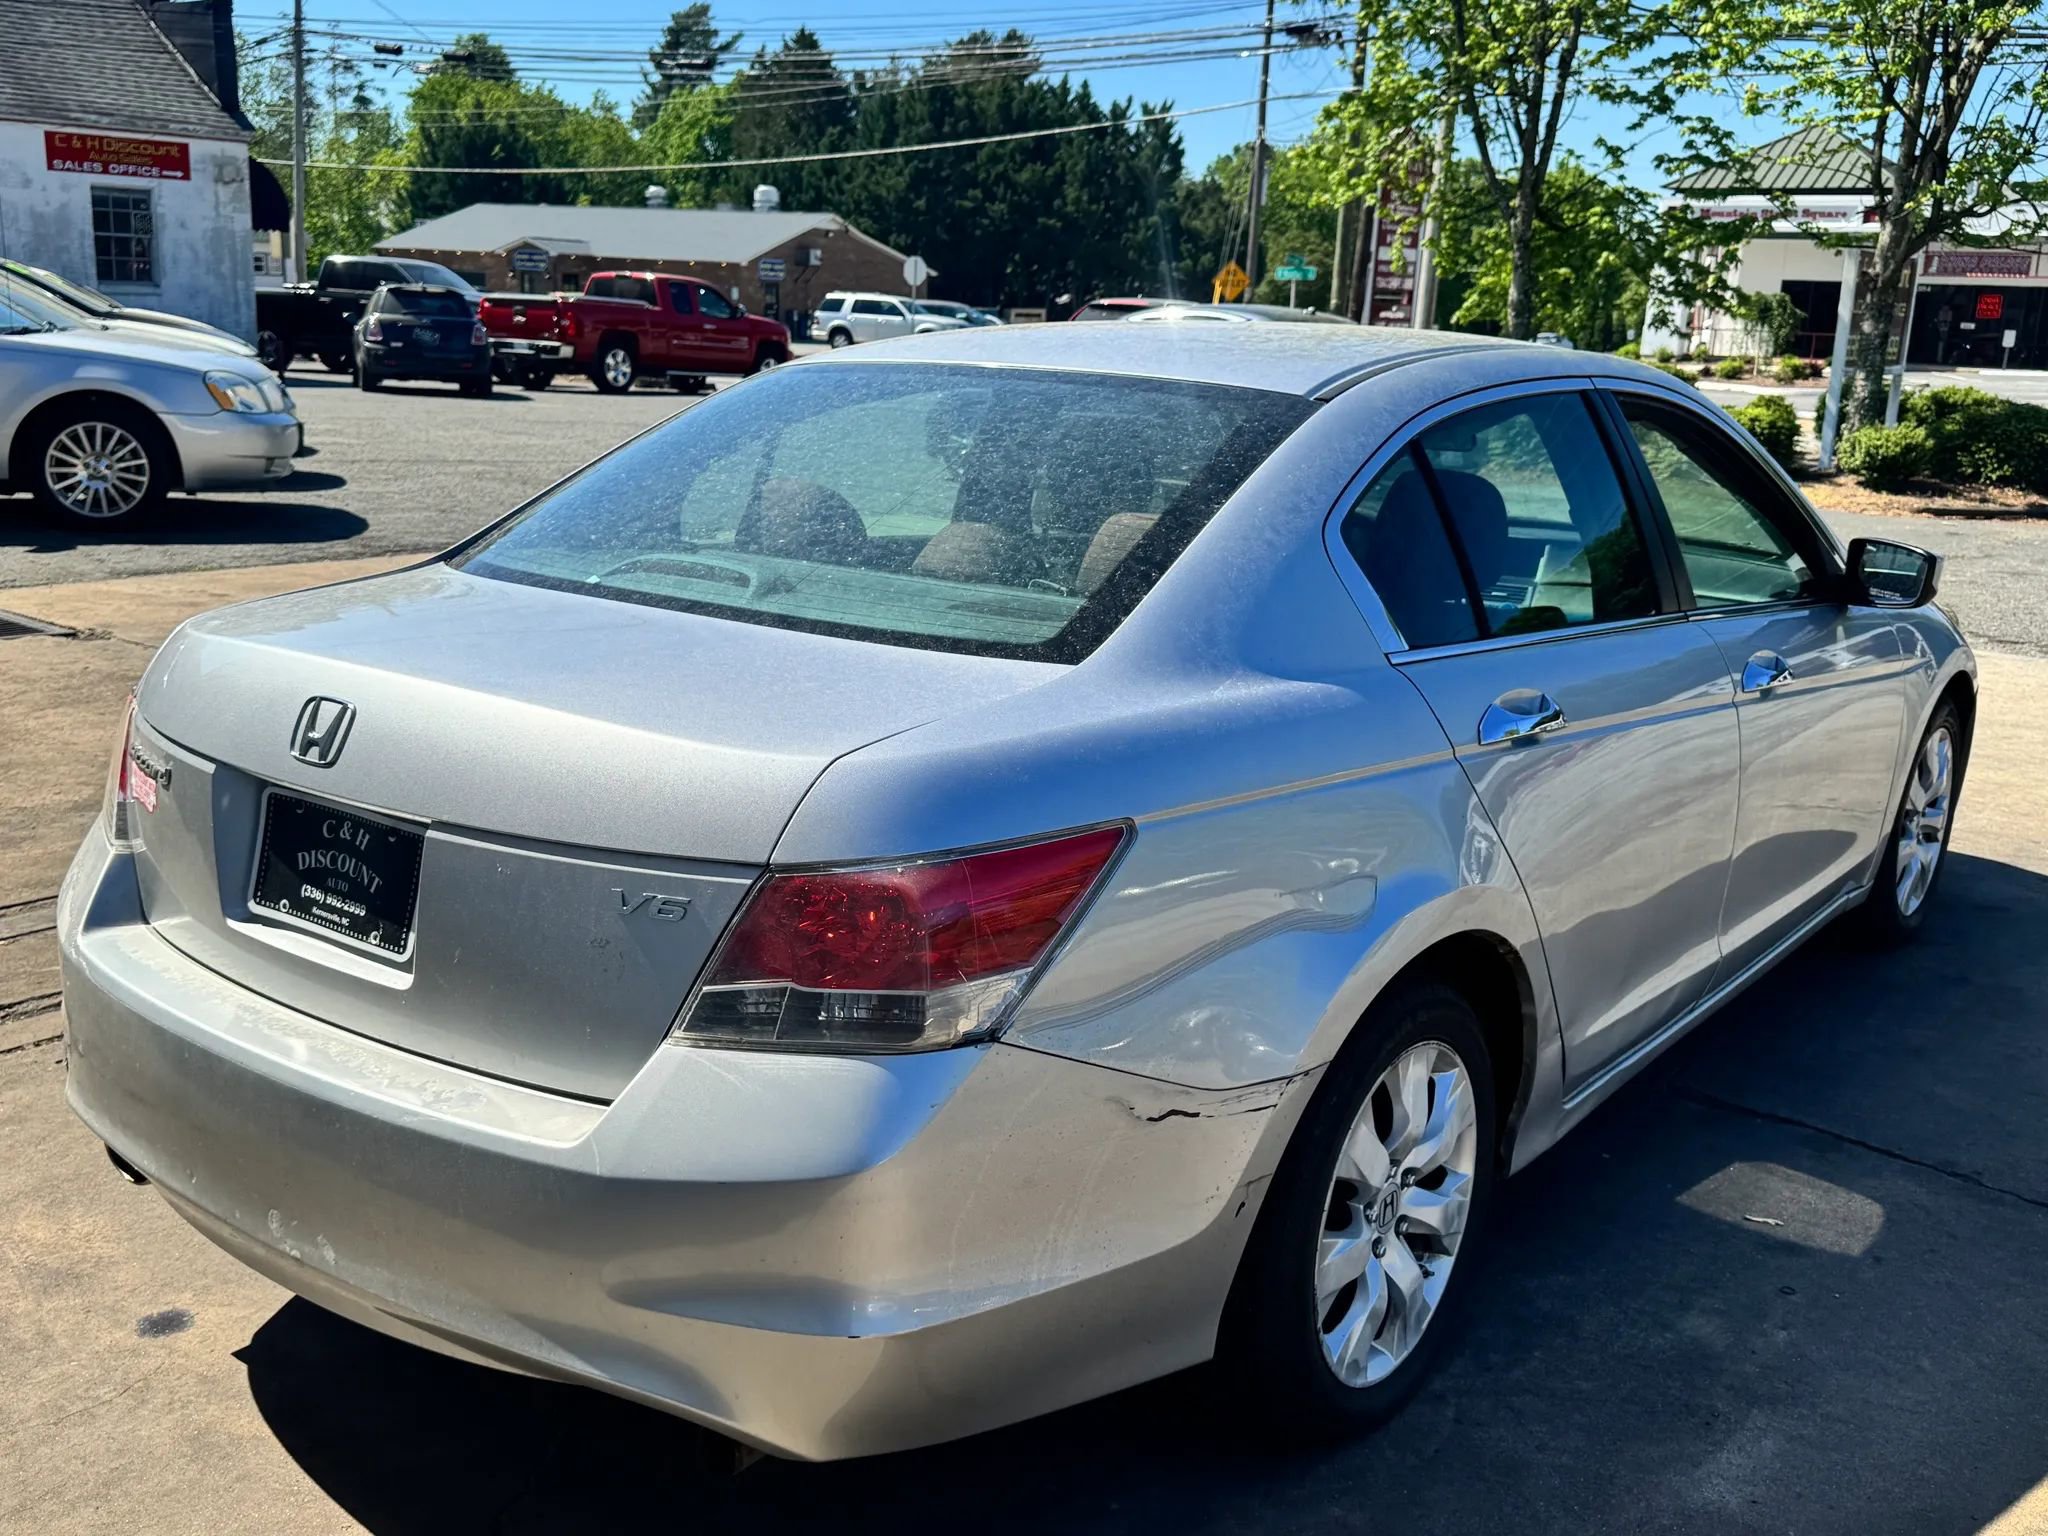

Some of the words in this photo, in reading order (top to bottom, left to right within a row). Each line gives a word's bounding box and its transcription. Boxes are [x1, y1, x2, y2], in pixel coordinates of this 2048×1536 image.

[54, 133, 67, 147] C
[71, 136, 82, 149] &
[87, 137, 99, 150] H
[52, 159, 103, 173] SALES
[108, 163, 161, 177] OFFICE
[1761, 208, 1798, 219] Strt
[1802, 208, 1848, 220] Square
[322, 819, 336, 839] C
[339, 820, 353, 840] &
[355, 828, 371, 851] H
[297, 849, 383, 894] DISCOUNT
[301, 883, 325, 904] (336)
[326, 877, 349, 892] AUTO
[611, 888, 692, 921] V6
